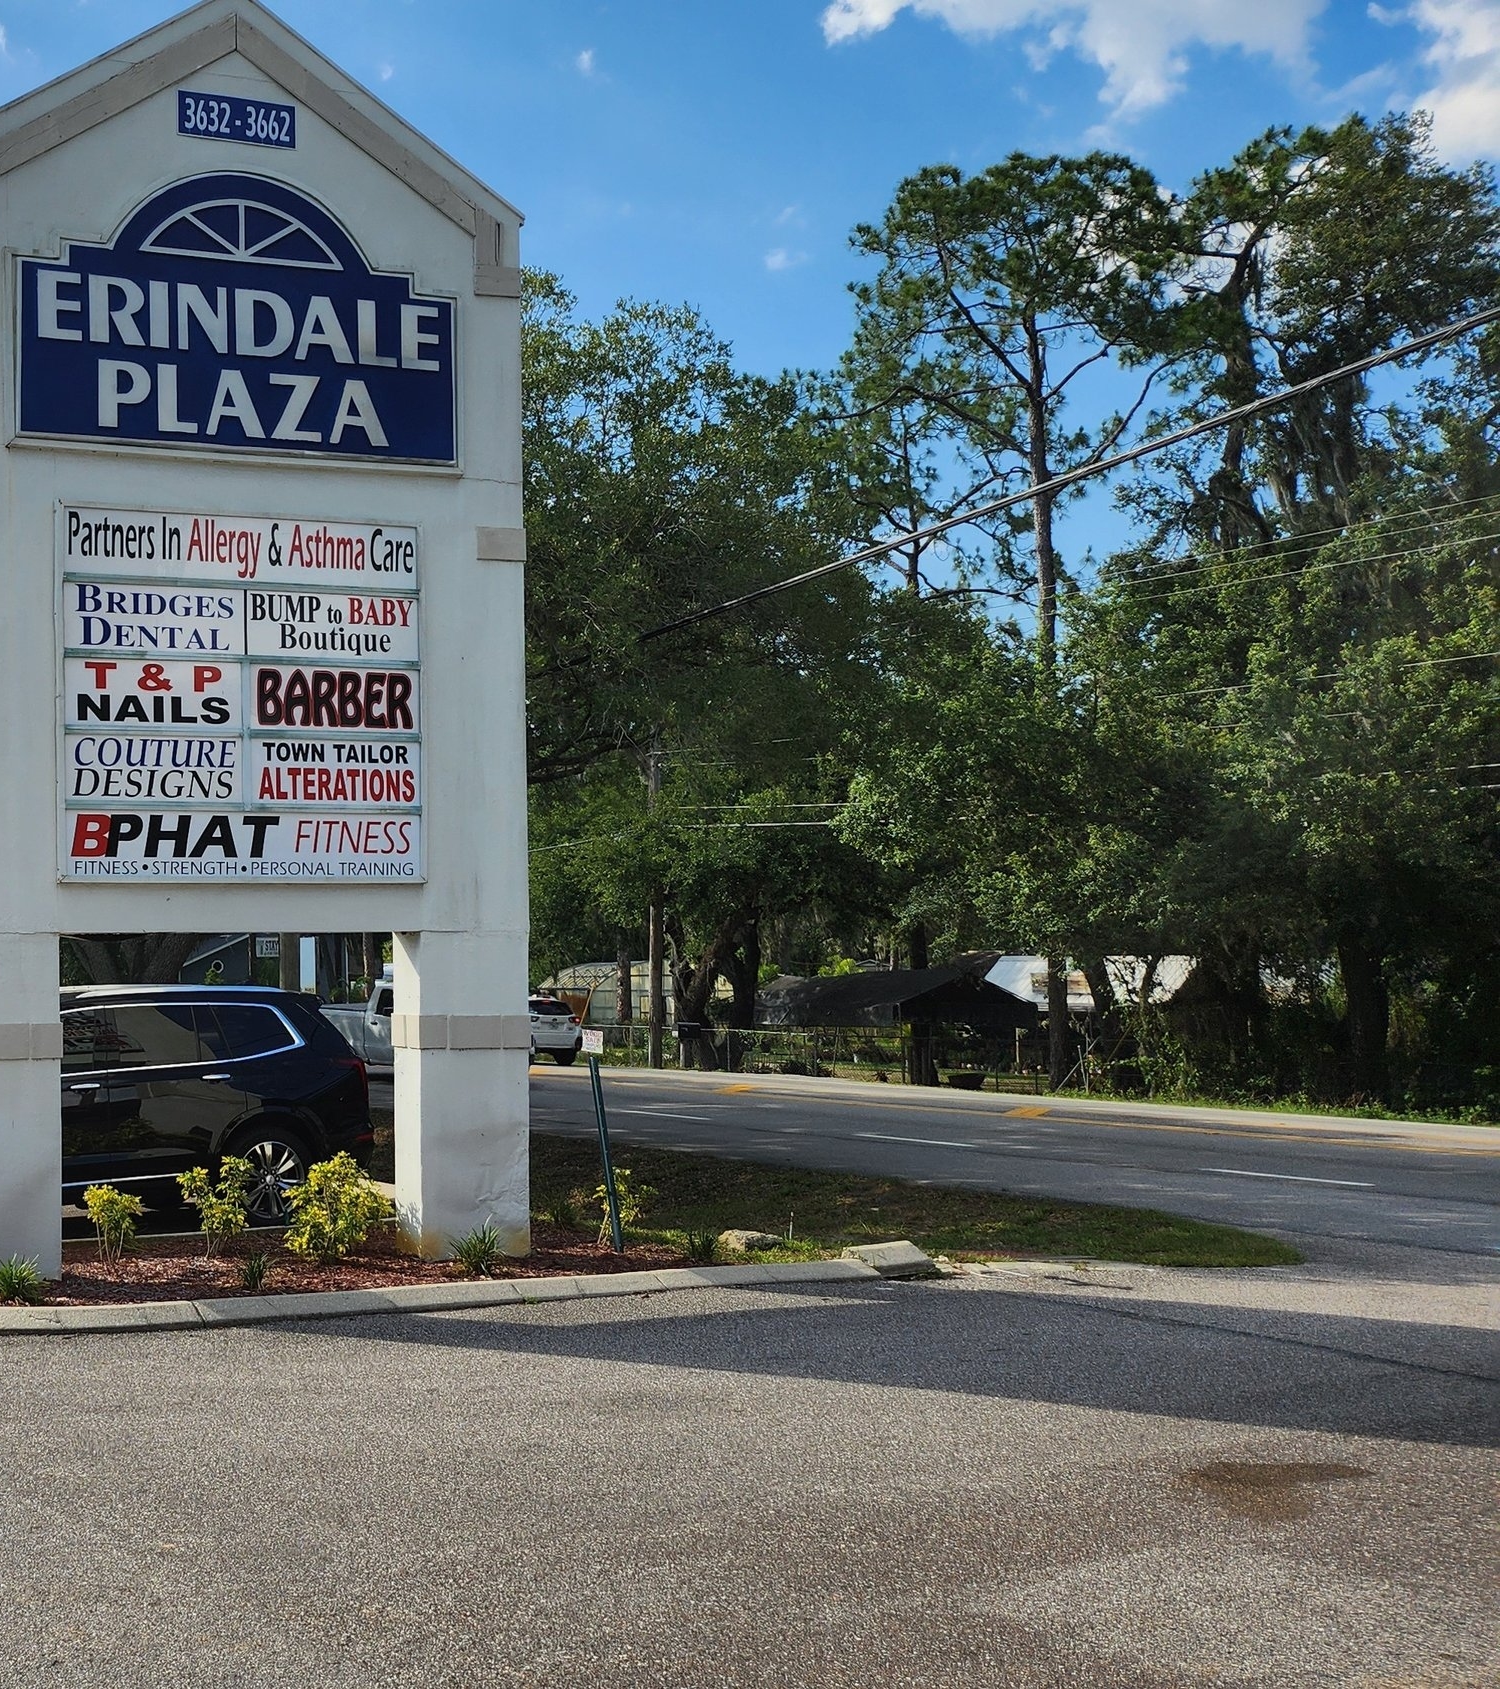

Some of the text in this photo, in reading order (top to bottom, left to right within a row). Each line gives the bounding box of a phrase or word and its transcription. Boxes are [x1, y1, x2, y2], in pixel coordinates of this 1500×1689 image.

[36, 268, 441, 373] ERINDALE
[97, 358, 390, 447] PLAZA
[68, 510, 414, 579] Partners In Allergy & Asthma Care
[75, 583, 235, 619] BRIDGES
[250, 593, 413, 628] BUMP to BABY
[79, 616, 230, 651] DENTAL
[279, 622, 391, 656] Boutique
[84, 661, 222, 693] T & P
[77, 694, 231, 725] NAILS
[256, 668, 414, 730] BARBER
[74, 737, 237, 769] COUTURE
[262, 742, 409, 764] TOWN TAILOR
[72, 768, 234, 799] DESIGNS
[259, 766, 416, 803] ALTERATIONS
[70, 813, 412, 859] BPHAT FITNESS
[74, 860, 415, 877] FITNESS STRENGTH PERSONAL TRAINING
